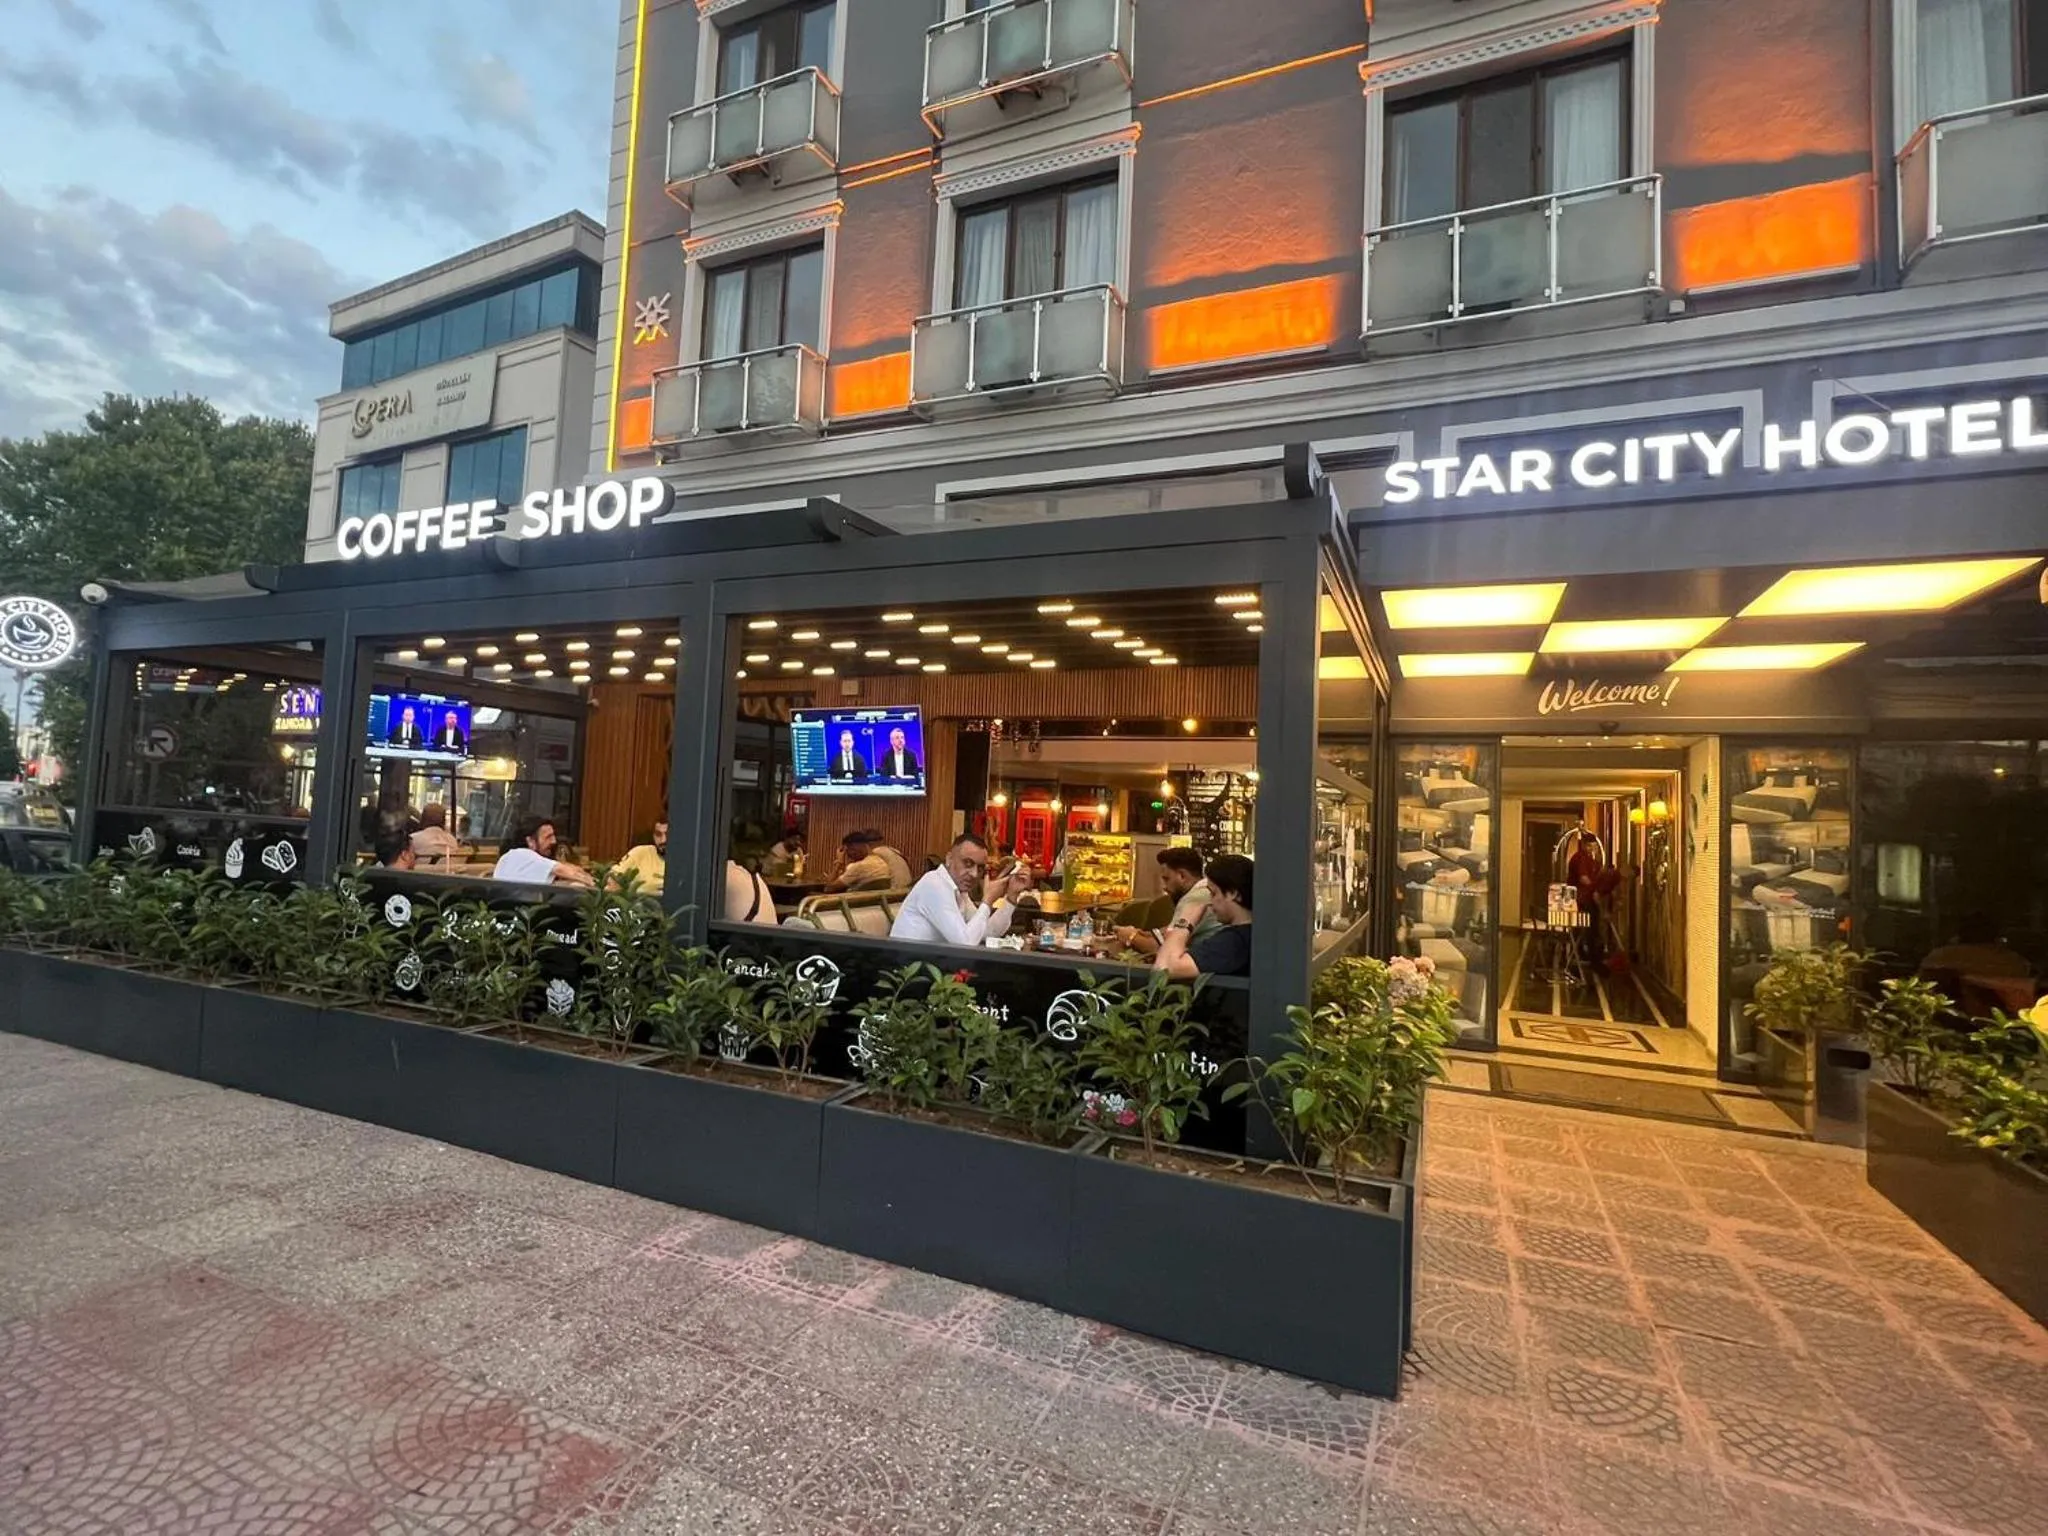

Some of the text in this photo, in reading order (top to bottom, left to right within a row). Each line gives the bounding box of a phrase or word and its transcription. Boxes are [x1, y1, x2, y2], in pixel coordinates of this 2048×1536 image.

[1383, 396, 2048, 504] STAR CITY HOTEL
[337, 476, 665, 560] COFFEE SHOP
[6, 601, 48, 614] CITY
[1538, 675, 1680, 716] Welcome!
